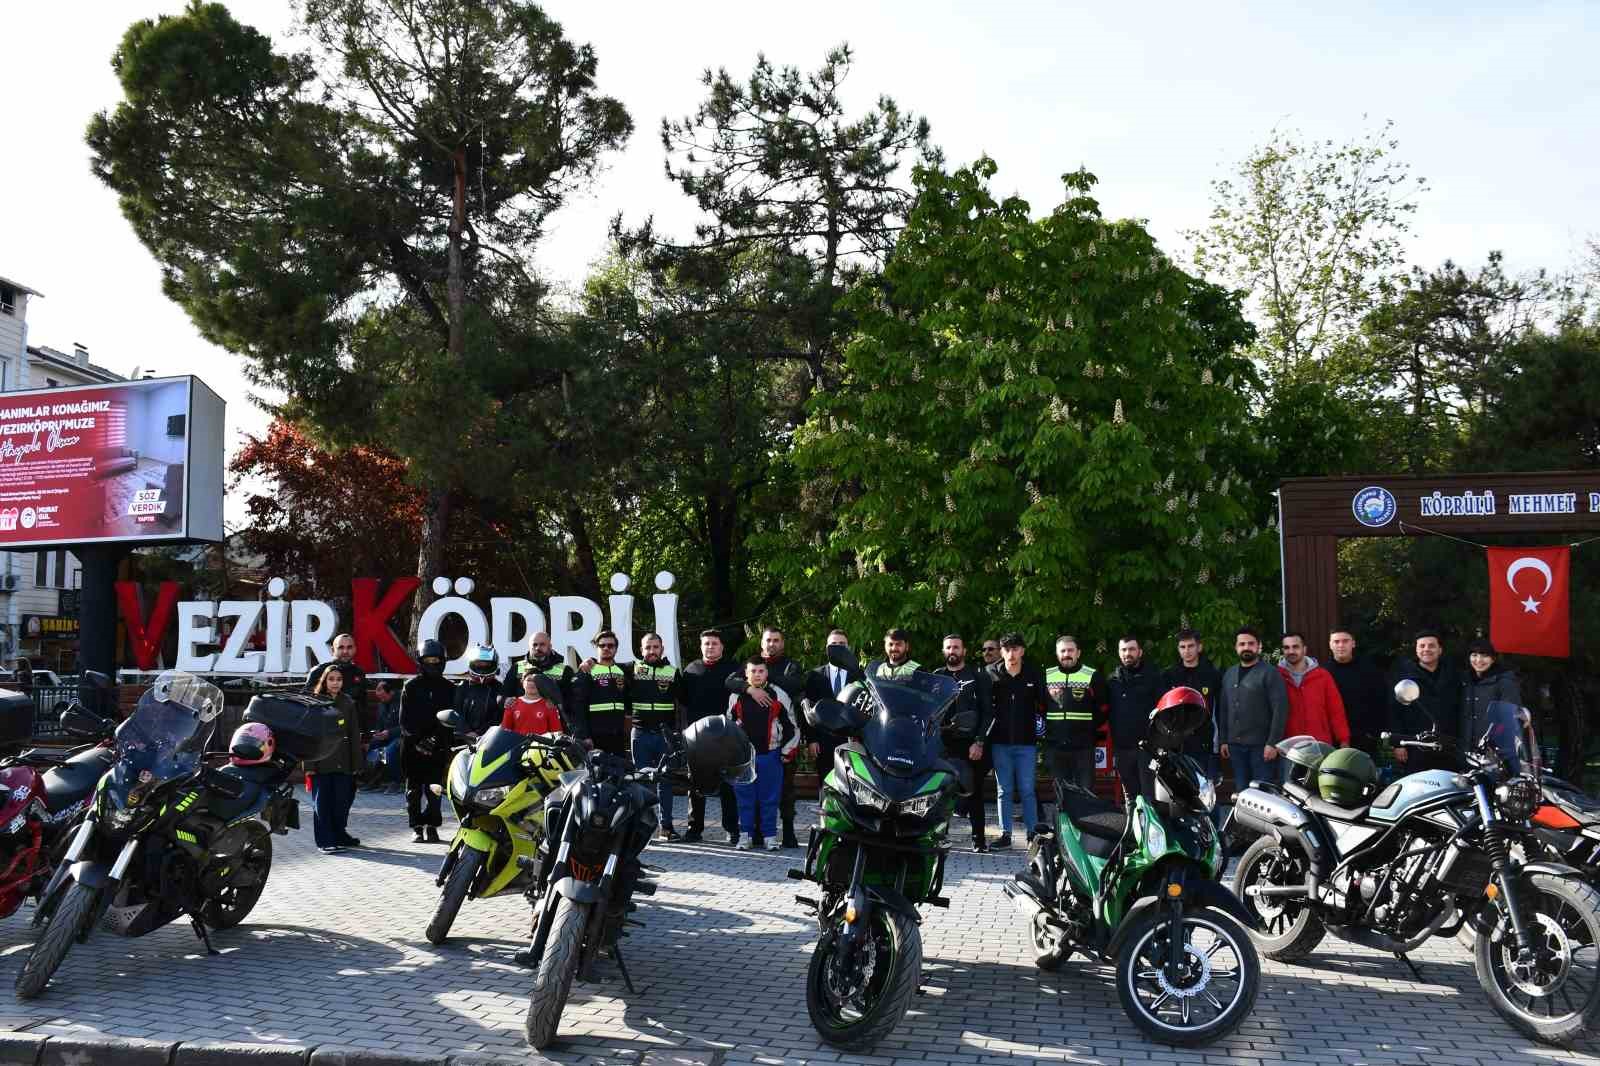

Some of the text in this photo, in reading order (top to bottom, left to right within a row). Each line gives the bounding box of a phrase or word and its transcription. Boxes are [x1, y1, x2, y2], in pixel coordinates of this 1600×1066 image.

[52, 400, 110, 416] KONAĞIMIZ
[1421, 490, 1496, 516] KÖPRÜLÜ
[1509, 493, 1576, 514] MEHMET
